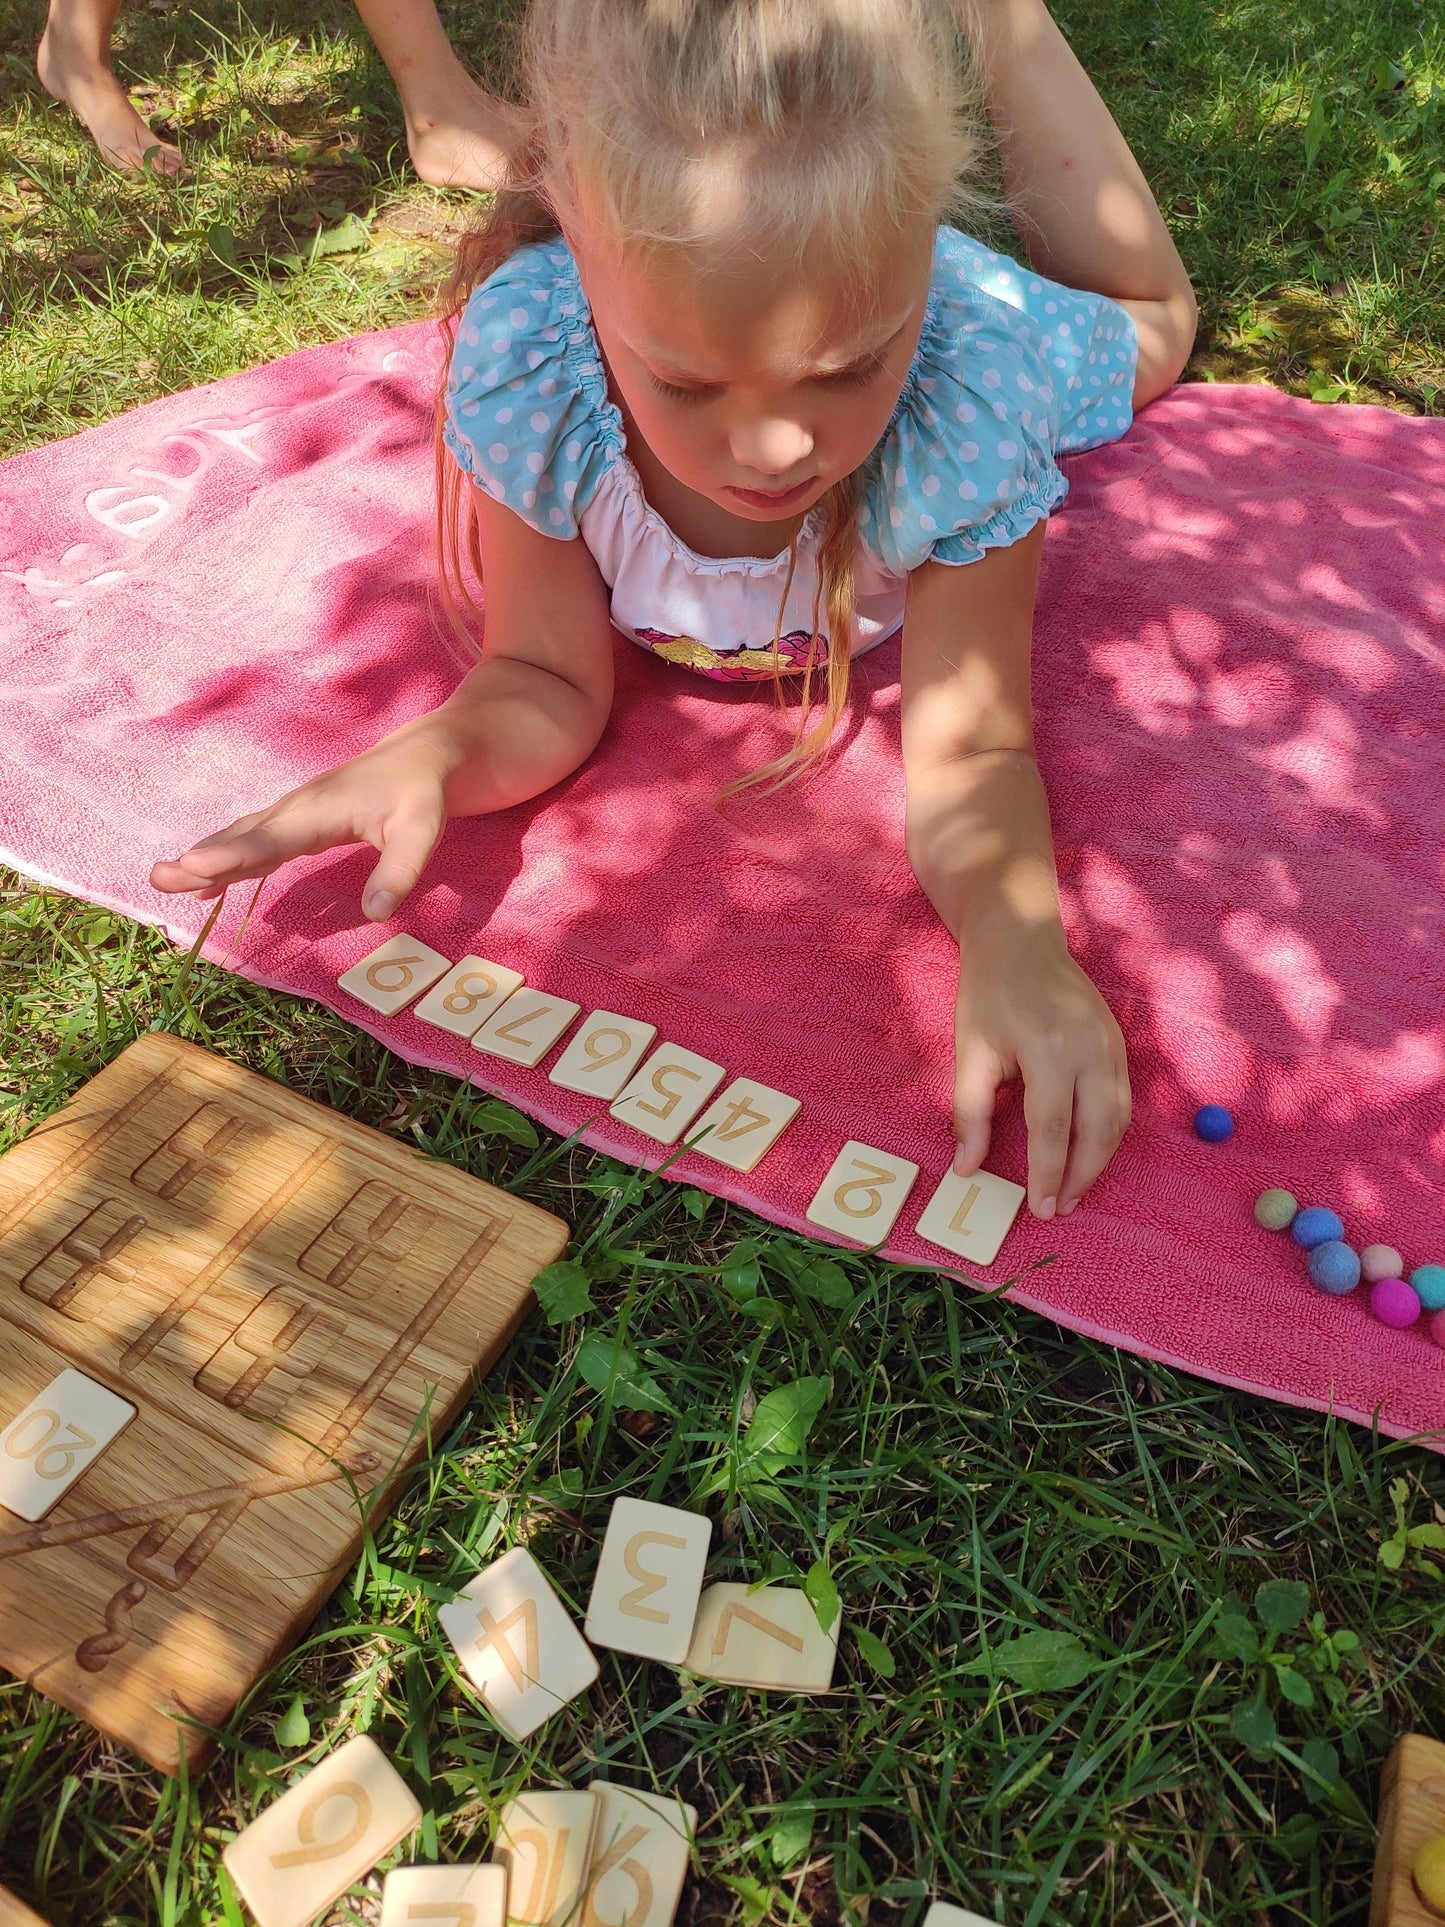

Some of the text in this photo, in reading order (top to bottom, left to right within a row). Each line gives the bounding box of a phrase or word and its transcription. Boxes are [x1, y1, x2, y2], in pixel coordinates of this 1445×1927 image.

[442, 971, 497, 1015] 8
[494, 1006, 553, 1047] 7
[635, 1064, 703, 1120] 5
[713, 1095, 772, 1142] 4
[833, 1158, 897, 1219] 2
[949, 1183, 982, 1236] 1
[4, 1408, 97, 1480] 20
[617, 1530, 687, 1624] 3
[475, 1599, 539, 1693] 4
[712, 1602, 805, 1655] 7
